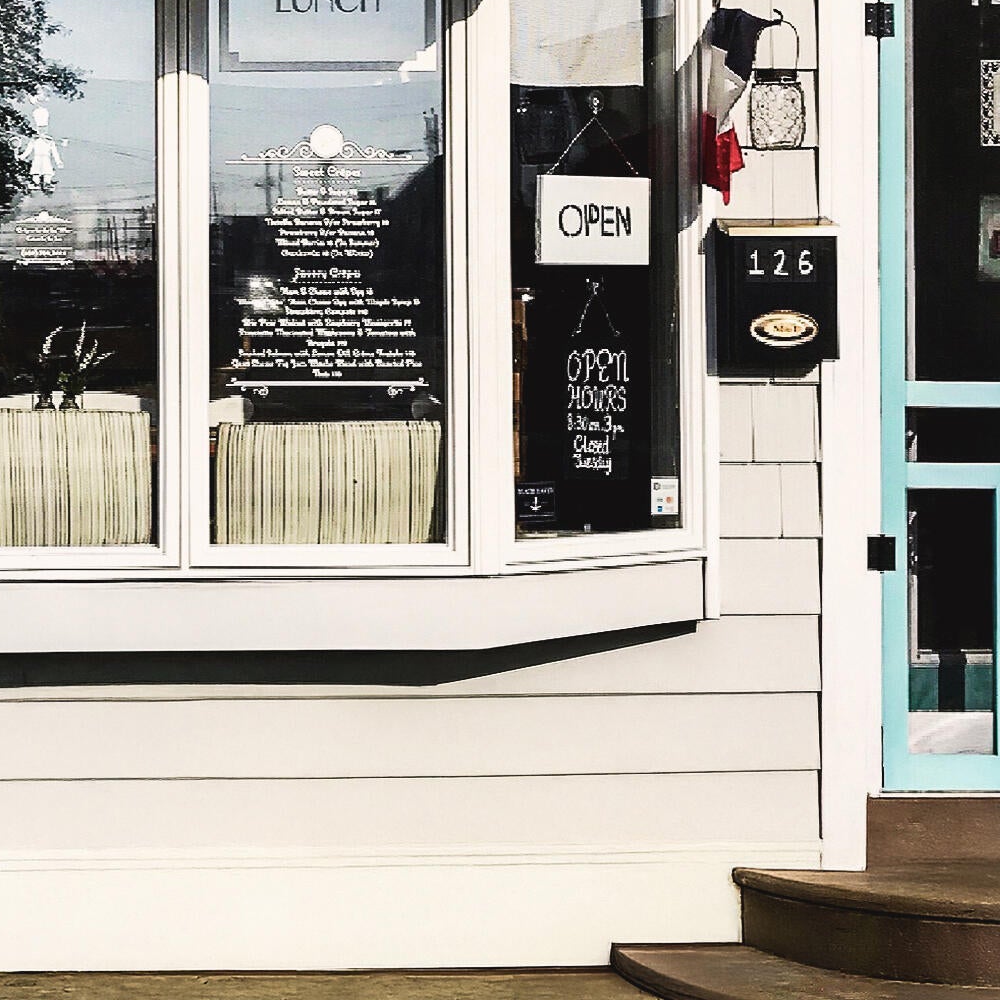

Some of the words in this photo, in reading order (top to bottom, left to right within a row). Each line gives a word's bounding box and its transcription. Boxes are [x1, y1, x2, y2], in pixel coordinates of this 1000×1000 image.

[558, 203, 632, 238] OPEN
[748, 249, 814, 276] 126
[567, 383, 627, 412] HOURS
